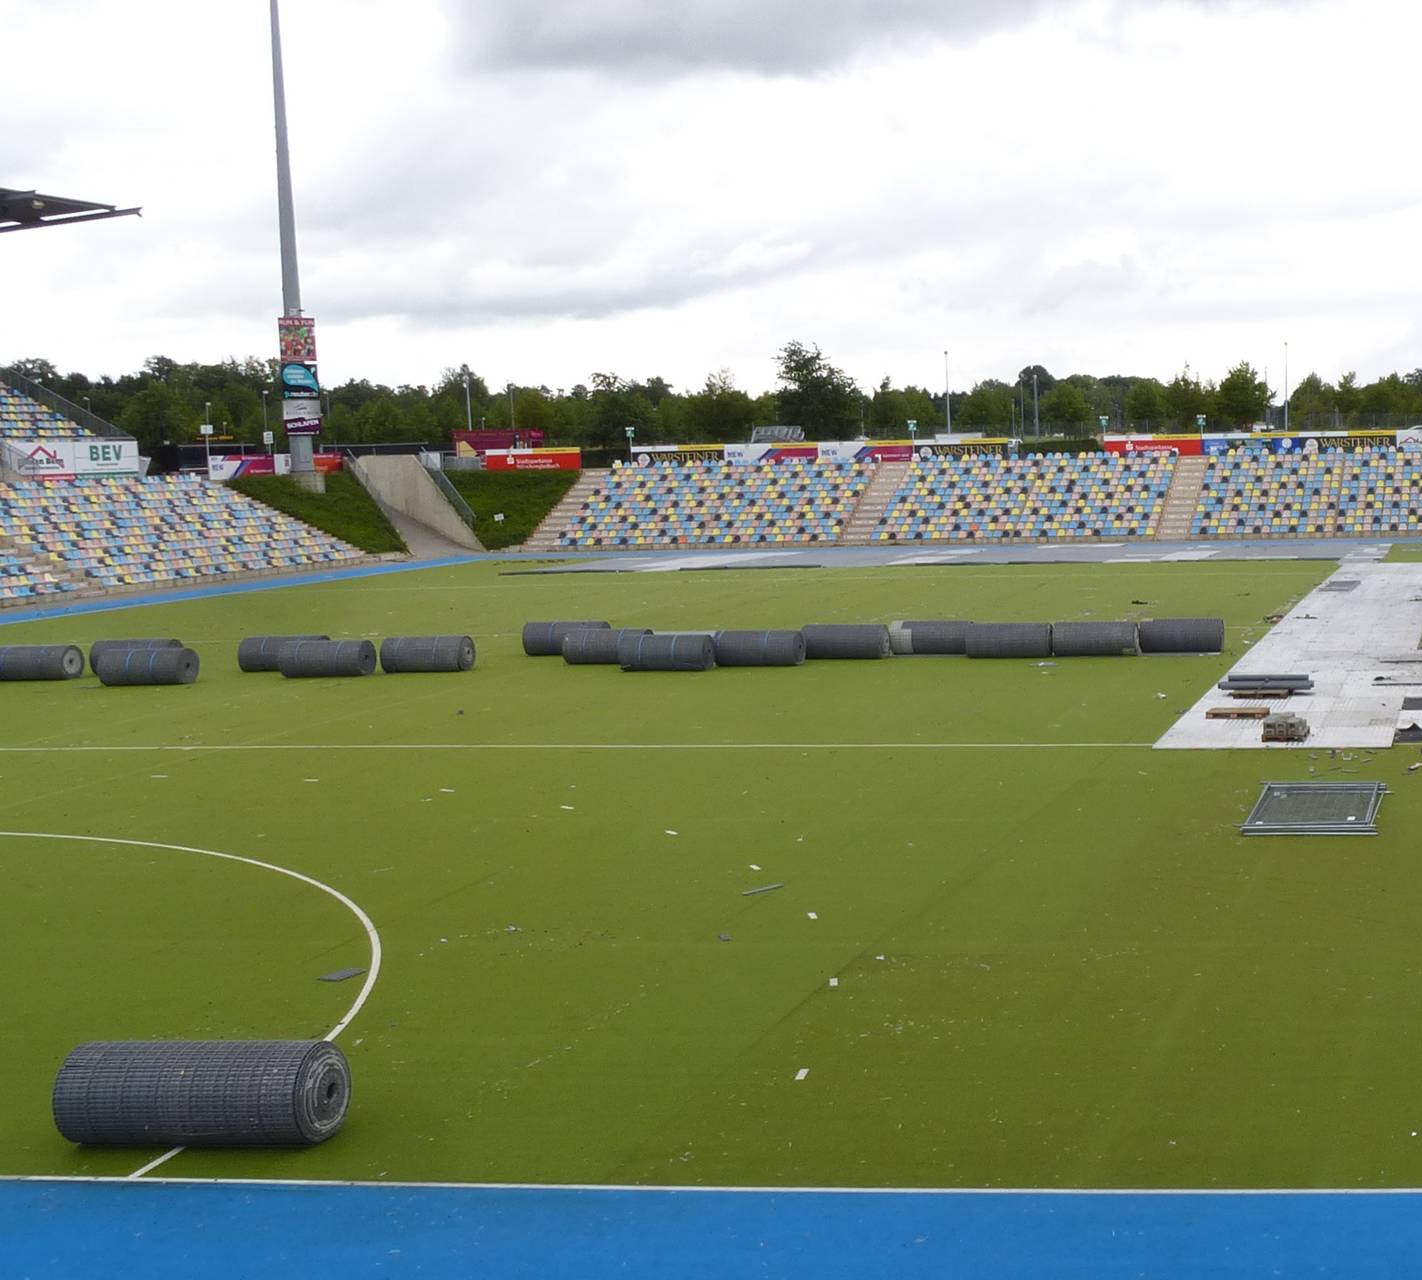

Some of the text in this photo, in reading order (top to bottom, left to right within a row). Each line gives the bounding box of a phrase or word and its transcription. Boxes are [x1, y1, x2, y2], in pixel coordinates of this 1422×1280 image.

[1320, 436, 1392, 449] WARSTEINER
[89, 444, 122, 461] BEV
[934, 444, 1003, 456] WARSTEINER
[650, 451, 720, 463] WARSTEINER
